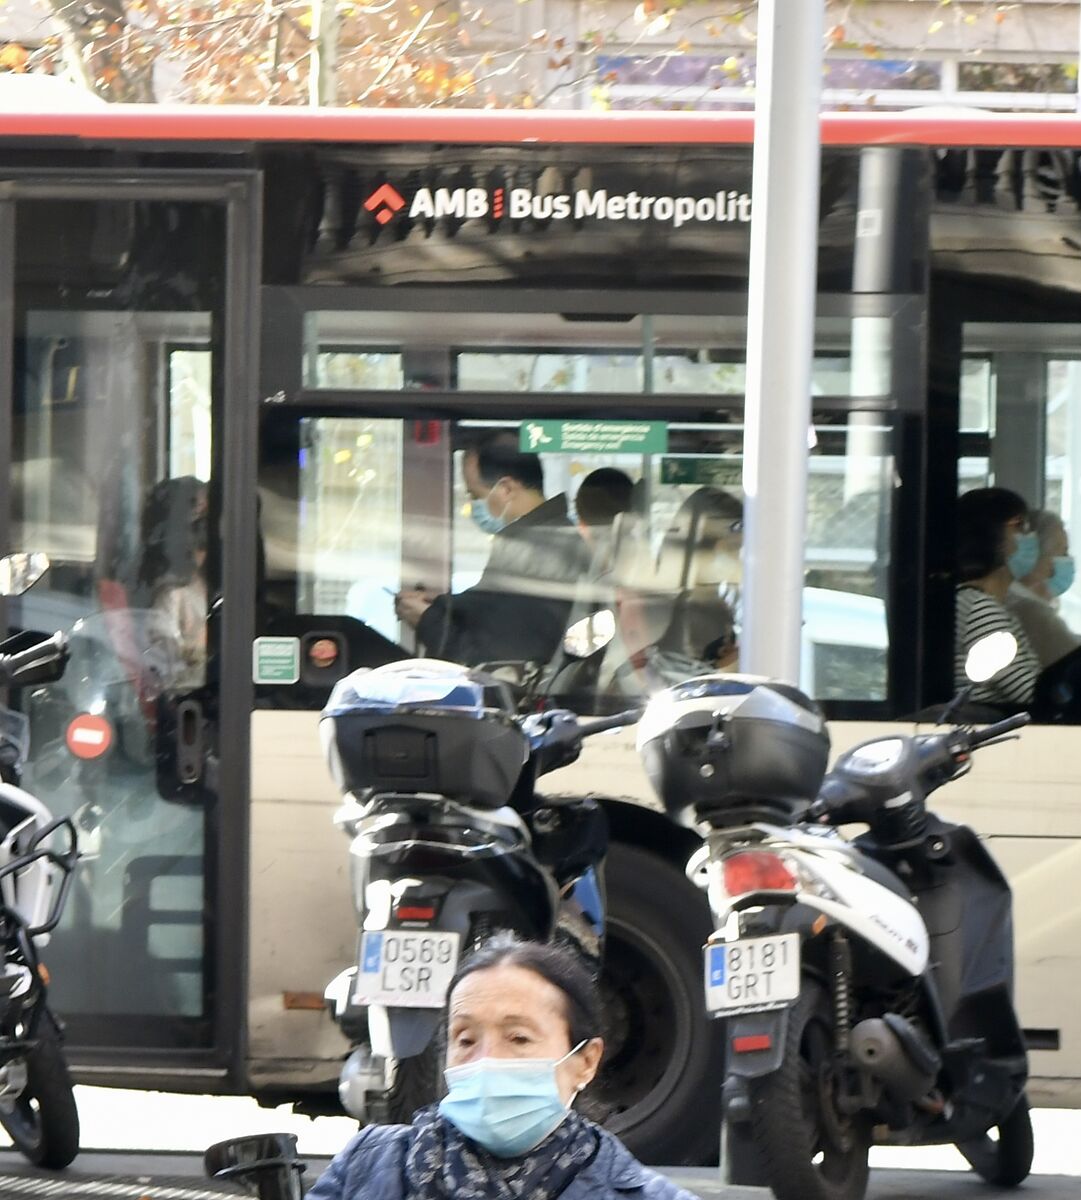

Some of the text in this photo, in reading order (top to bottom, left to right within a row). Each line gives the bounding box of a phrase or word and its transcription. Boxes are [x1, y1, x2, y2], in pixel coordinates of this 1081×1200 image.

[409, 187, 489, 219] AMB
[509, 188, 752, 227] Bus Metropolit
[383, 937, 453, 964] 0569
[727, 940, 790, 973] 8181
[381, 965, 433, 993] LSR
[726, 970, 775, 1001] GRT
